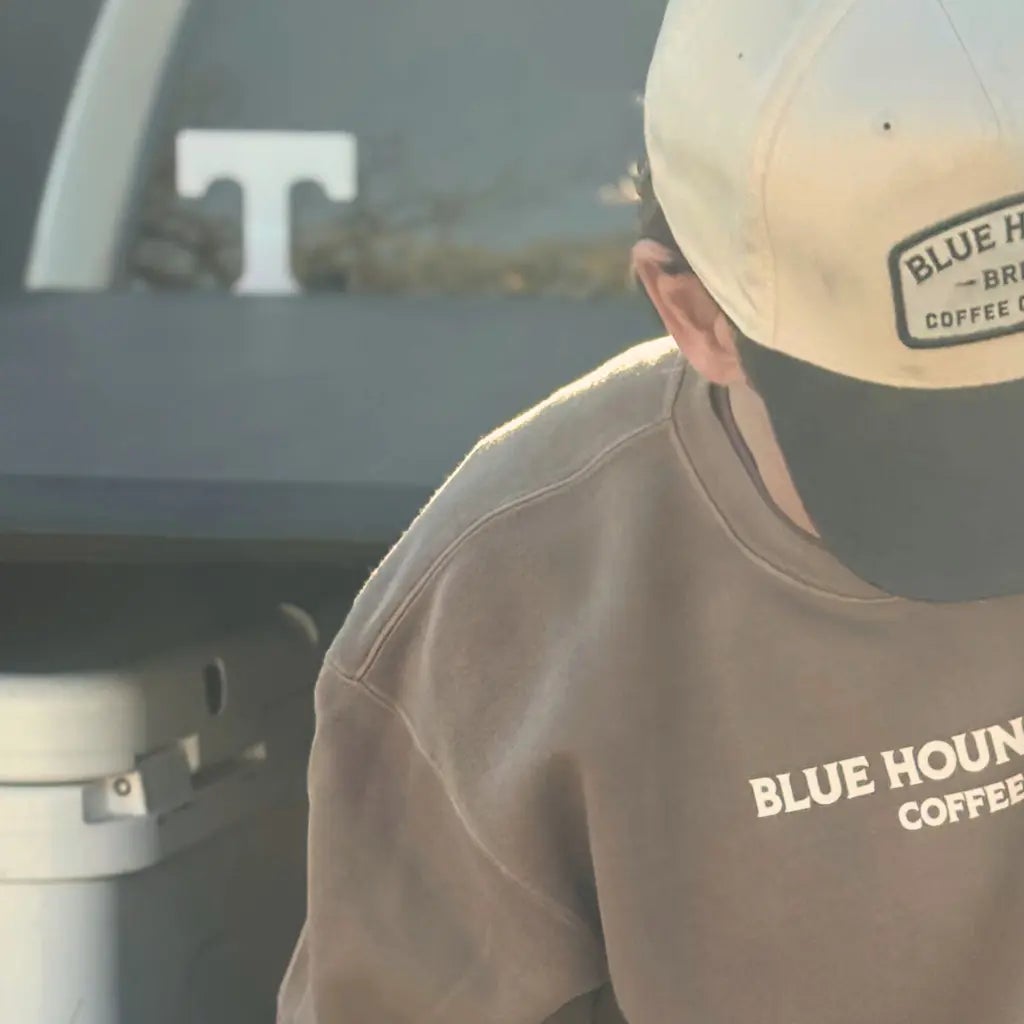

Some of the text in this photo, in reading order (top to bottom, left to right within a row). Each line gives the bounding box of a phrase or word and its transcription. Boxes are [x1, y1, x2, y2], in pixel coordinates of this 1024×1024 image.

[904, 223, 996, 285] BLUE
[926, 300, 1010, 330] COFFEE
[748, 755, 876, 818] BLUE
